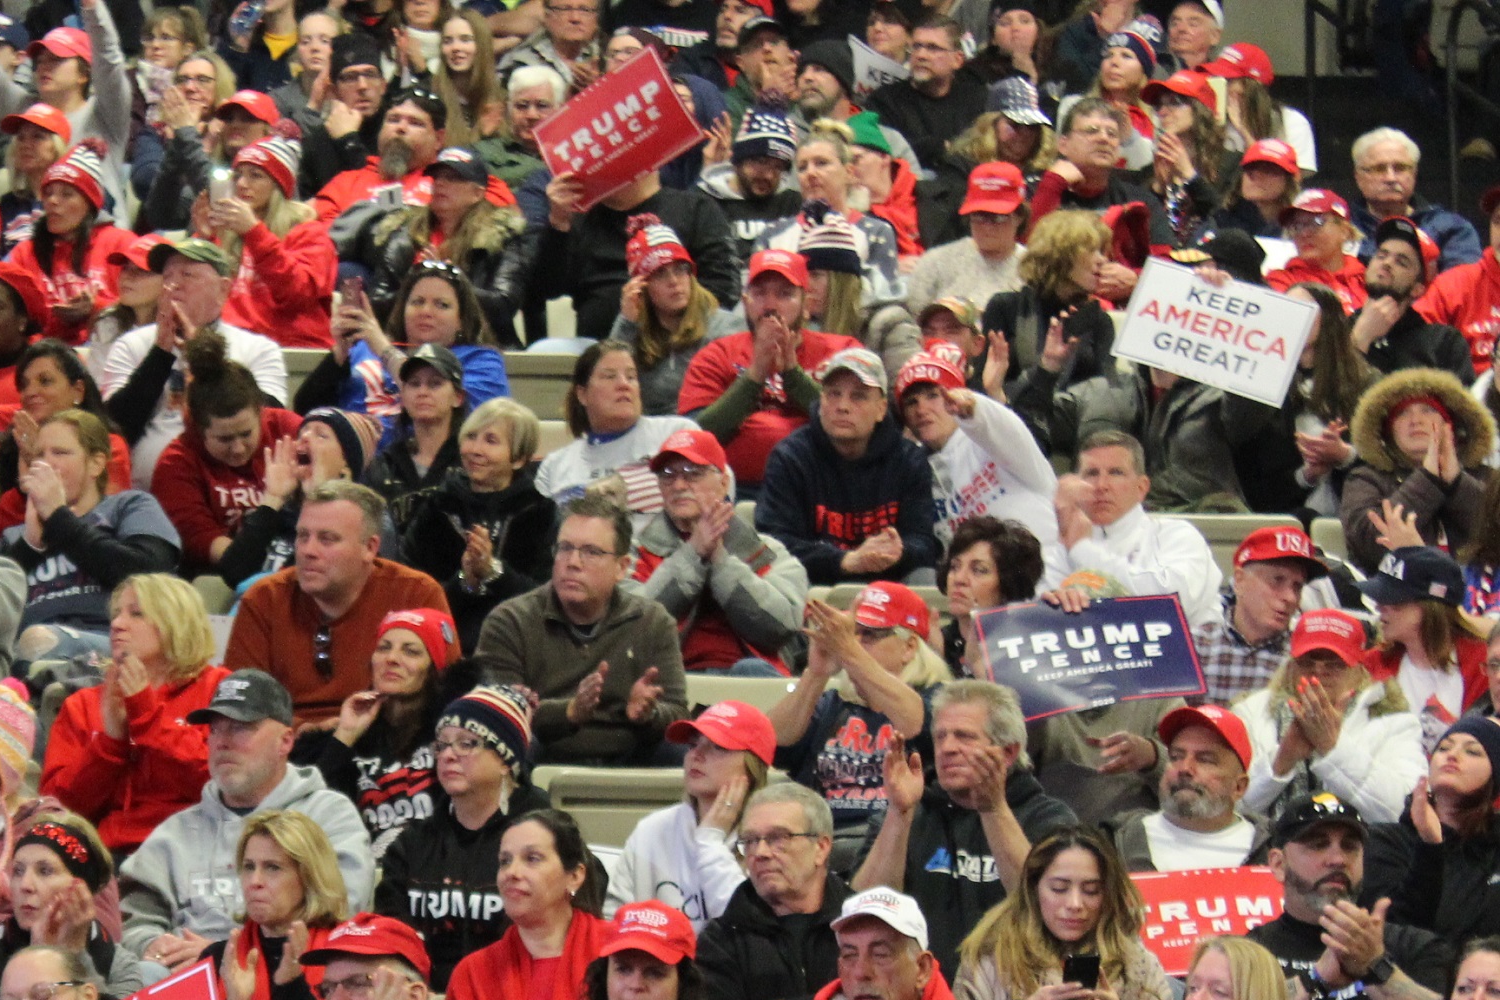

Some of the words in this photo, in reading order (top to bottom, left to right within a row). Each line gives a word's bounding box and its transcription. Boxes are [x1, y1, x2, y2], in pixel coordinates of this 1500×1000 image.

[553, 81, 661, 161] TRUMP
[570, 107, 660, 172] PENCE
[1188, 284, 1261, 319] KEEP
[1138, 300, 1287, 362] AMERICA
[1153, 332, 1257, 380] GREAT!
[998, 621, 1173, 658] TRUMP
[1020, 642, 1164, 672] PENCE
[1037, 669, 1071, 683] KEEP
[1074, 662, 1125, 679] AMERICA
[1125, 657, 1155, 671] GREAT!
[407, 889, 504, 922] TRUMP
[1163, 932, 1193, 948] KEEP
